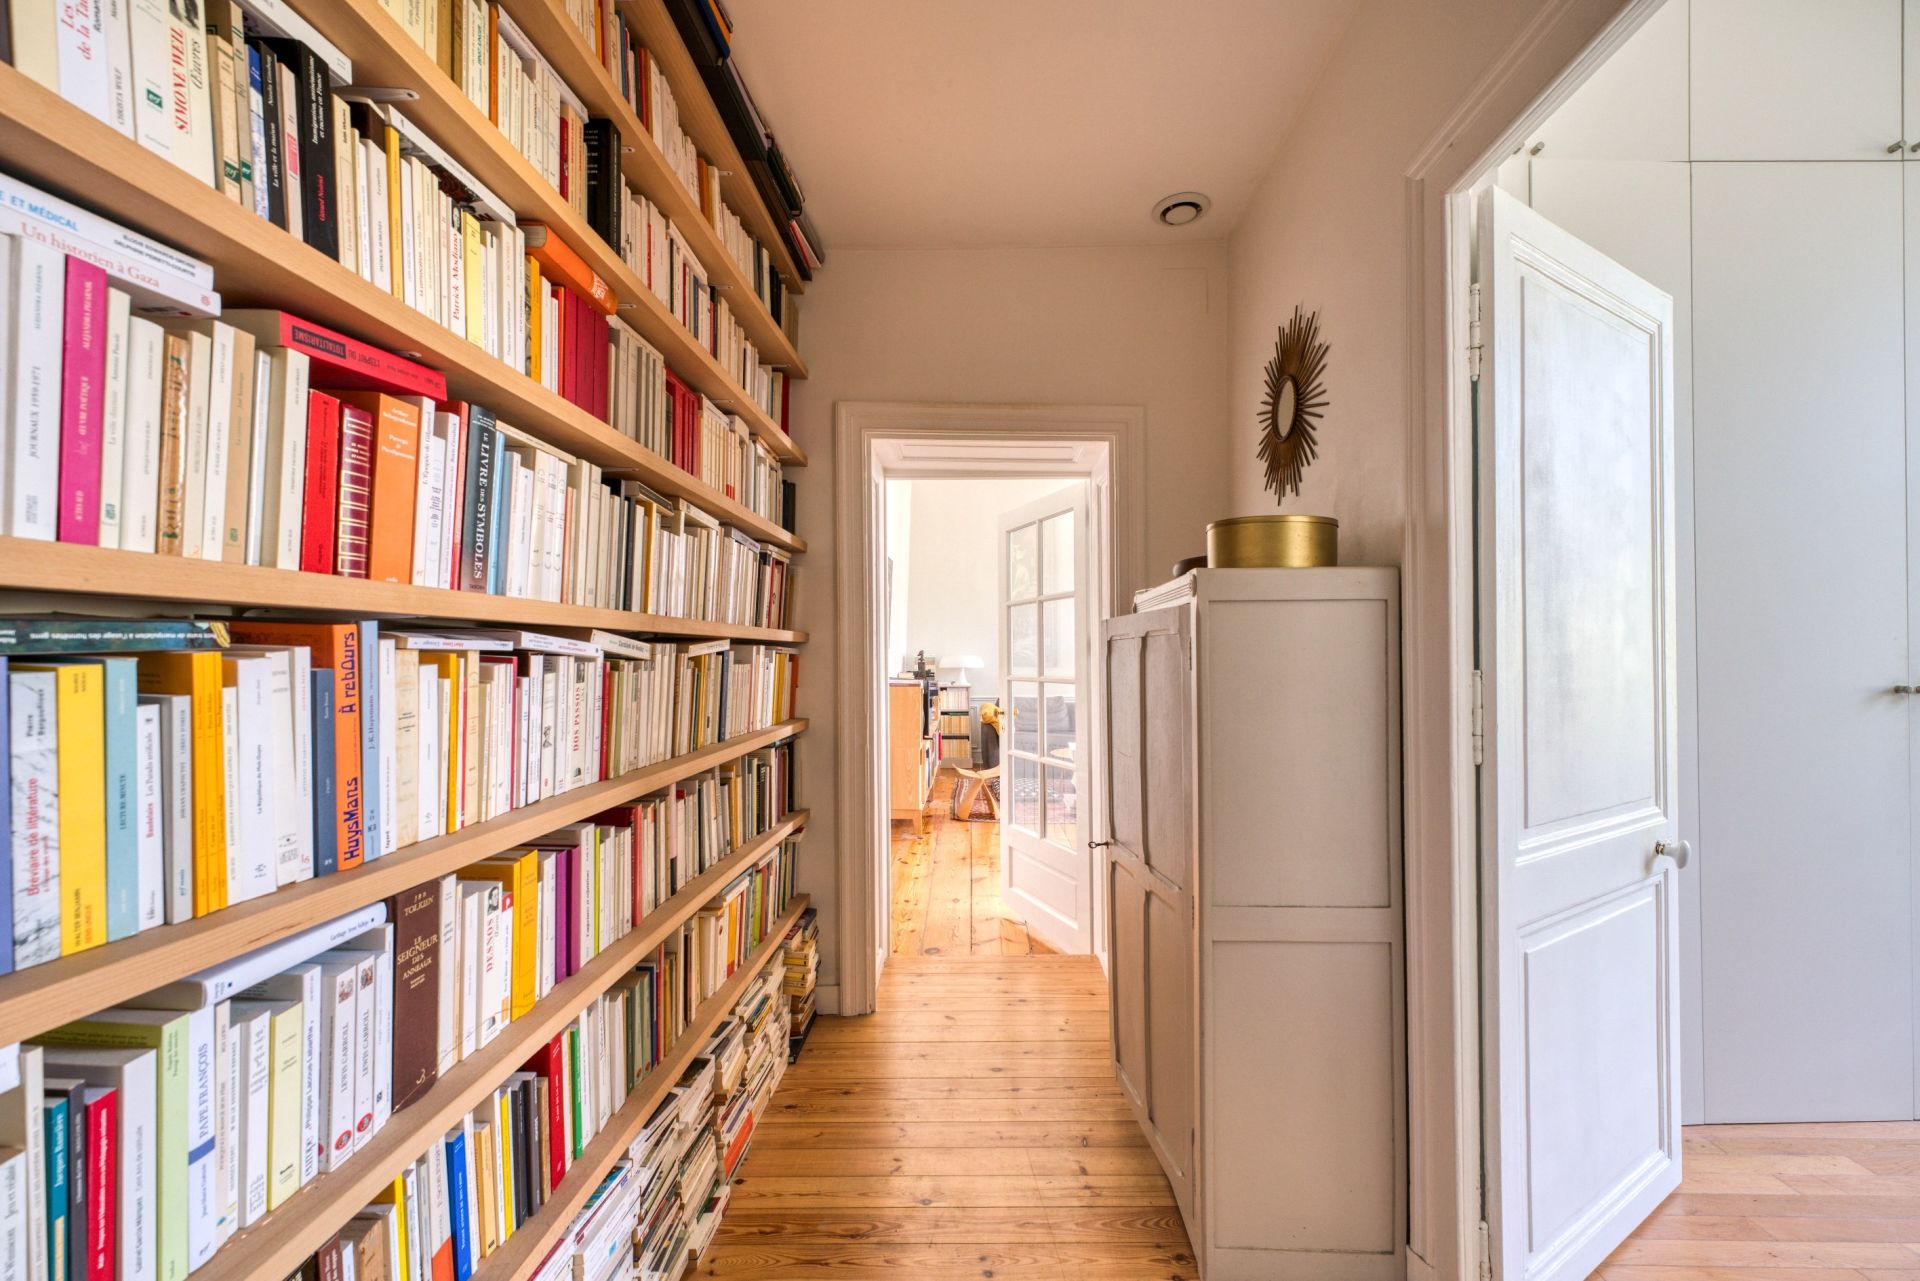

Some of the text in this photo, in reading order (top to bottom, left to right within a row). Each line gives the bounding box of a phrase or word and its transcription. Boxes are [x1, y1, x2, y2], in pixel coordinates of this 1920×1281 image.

[170, 27, 188, 134] SIMONE WEIL
[116, 92, 125, 125] CHRISTA
[10, 195, 79, 232] ET MÉDICAL
[21, 222, 47, 243] Un
[50, 233, 114, 276] historien
[127, 266, 160, 289] Gaza
[294, 328, 345, 356] TOTALITARISME
[29, 410, 40, 459] JOURNAUX
[484, 432, 489, 443] LE
[478, 445, 489, 487] LIVRE
[474, 503, 486, 579] SYMBOLES
[26, 714, 34, 737] Pierre
[27, 777, 40, 896] Bréviaire de littérature
[404, 895, 433, 917] TOLKIEN
[397, 934, 438, 965] SEIGNEUR
[414, 935, 422, 945] LE
[403, 957, 432, 981] ANNEAUX
[412, 954, 424, 964] DES
[198, 1043, 208, 1138] PAPE FRANÇOIS
[54, 1112, 65, 1188] Jacques Rancière
